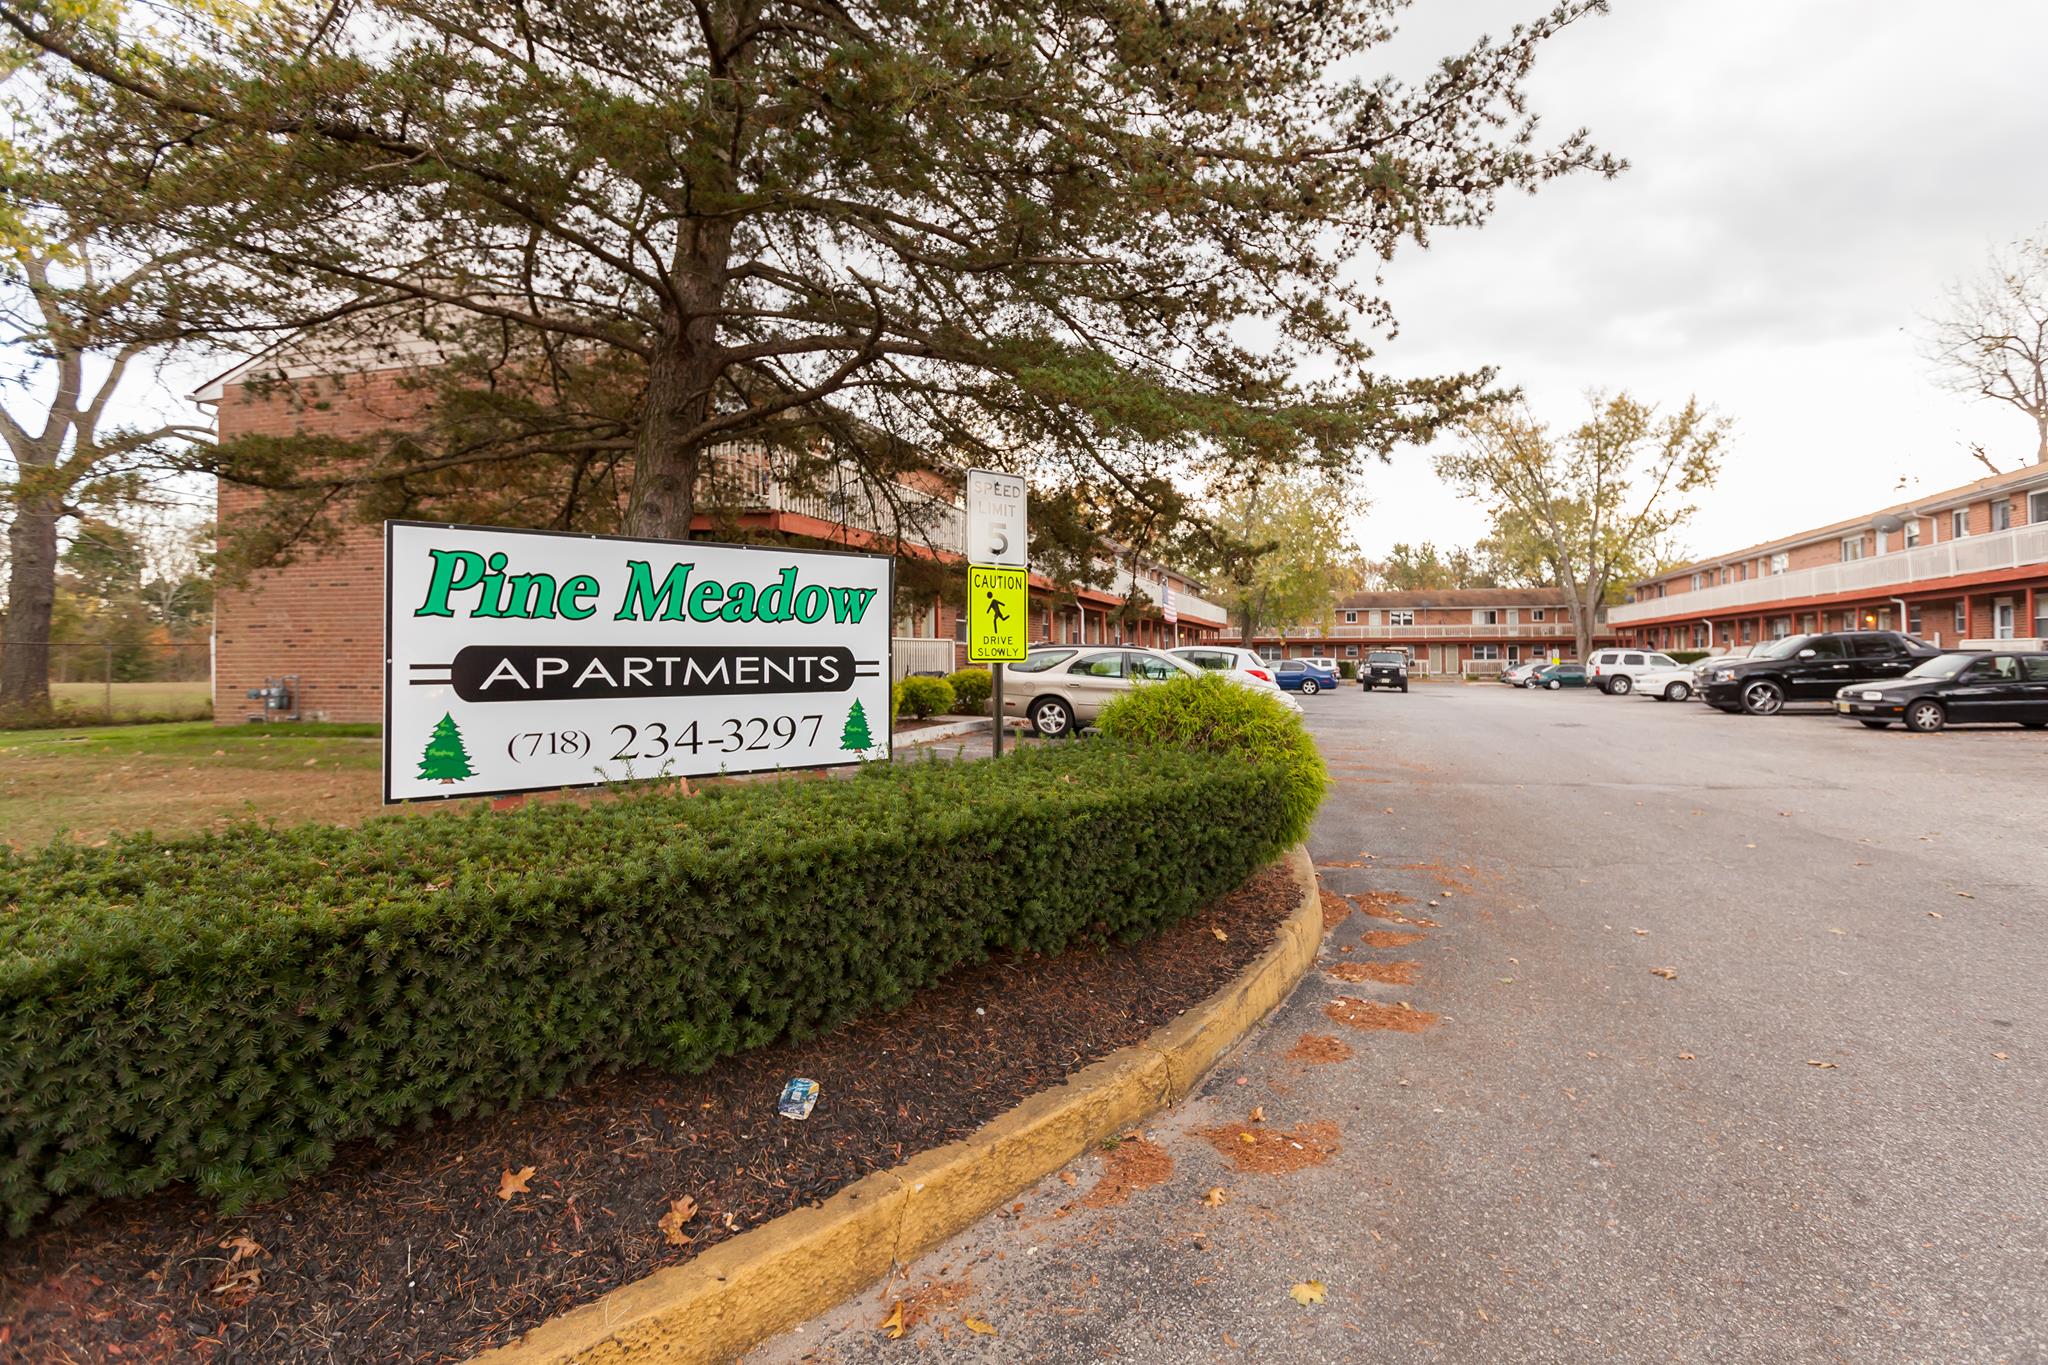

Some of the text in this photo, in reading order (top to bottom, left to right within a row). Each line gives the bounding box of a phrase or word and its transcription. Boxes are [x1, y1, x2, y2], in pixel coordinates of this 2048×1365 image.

[974, 480, 1021, 499] SPEED
[978, 501, 1016, 518] LIMIT
[988, 522, 1009, 556] 5
[414, 549, 877, 625] Pine Meadow
[974, 574, 1023, 591] CAUTION
[983, 636, 1014, 646] DRIVE
[977, 647, 1019, 657] SLOWLY
[479, 656, 840, 690] APARTMENTS
[507, 714, 823, 763] (718) 234-3297
